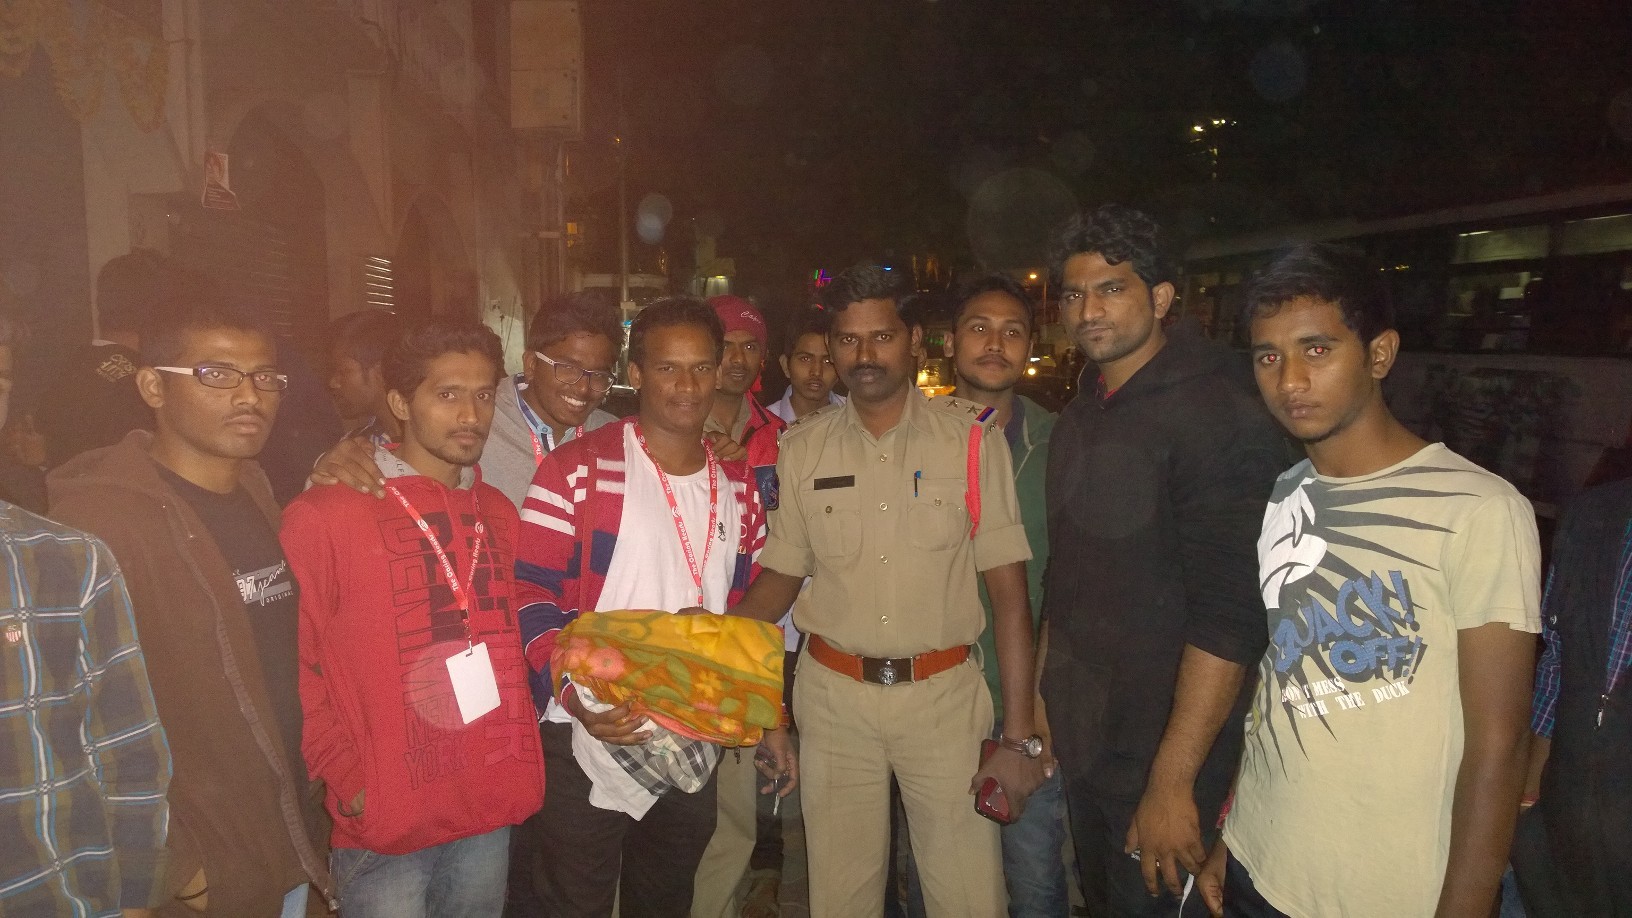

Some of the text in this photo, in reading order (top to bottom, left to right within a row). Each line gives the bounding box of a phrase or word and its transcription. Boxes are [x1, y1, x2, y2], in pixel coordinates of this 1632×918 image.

[399, 495, 410, 508] The
[678, 521, 688, 541] Hearts
[472, 537, 481, 558] Hearts
[685, 541, 695, 563] Caring
[428, 533, 459, 592] The Caring Hearts
[266, 590, 294, 603] ORIGINAL
[1274, 569, 1416, 673] QUACK!
[1329, 635, 1425, 681] OFF!
[1311, 676, 1346, 697] MESS
[1296, 680, 1410, 719] WITH THE DUCK
